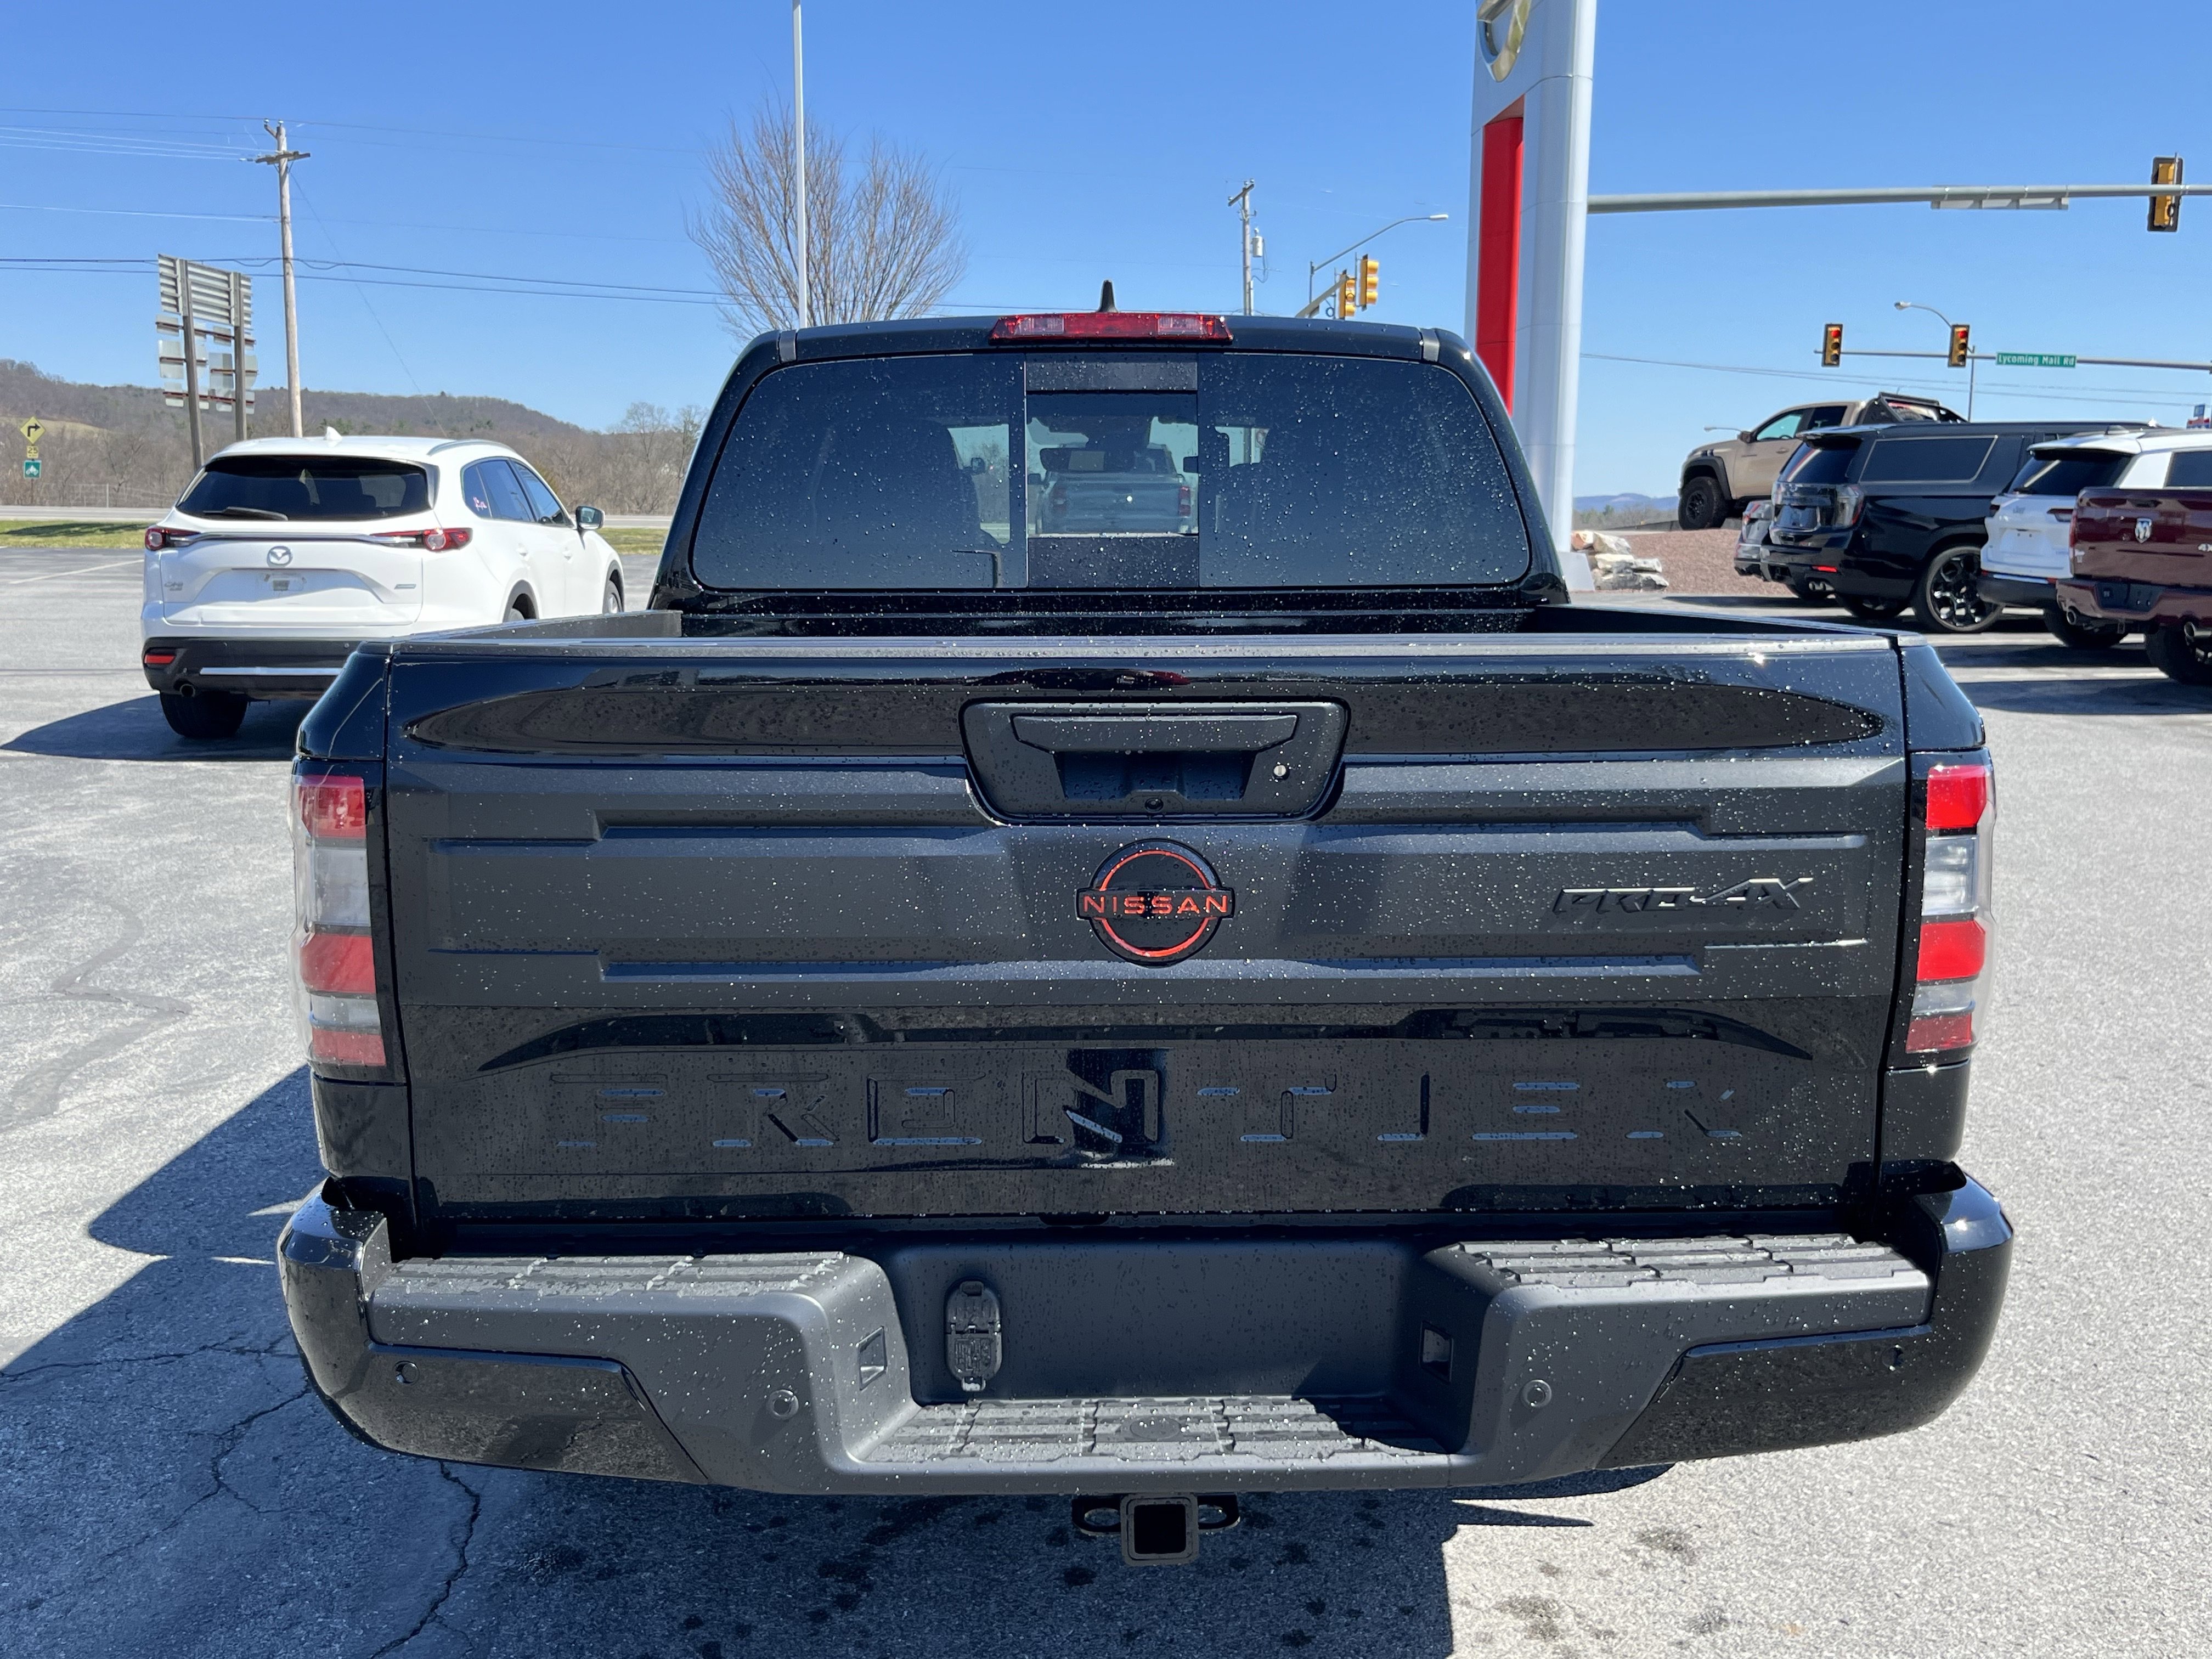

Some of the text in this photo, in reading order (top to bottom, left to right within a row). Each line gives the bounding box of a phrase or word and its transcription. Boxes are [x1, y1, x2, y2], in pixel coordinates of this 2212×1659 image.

[1998, 354, 2074, 366] Lycoming Mall Rd
[1082, 895, 1228, 915] NISSAN
